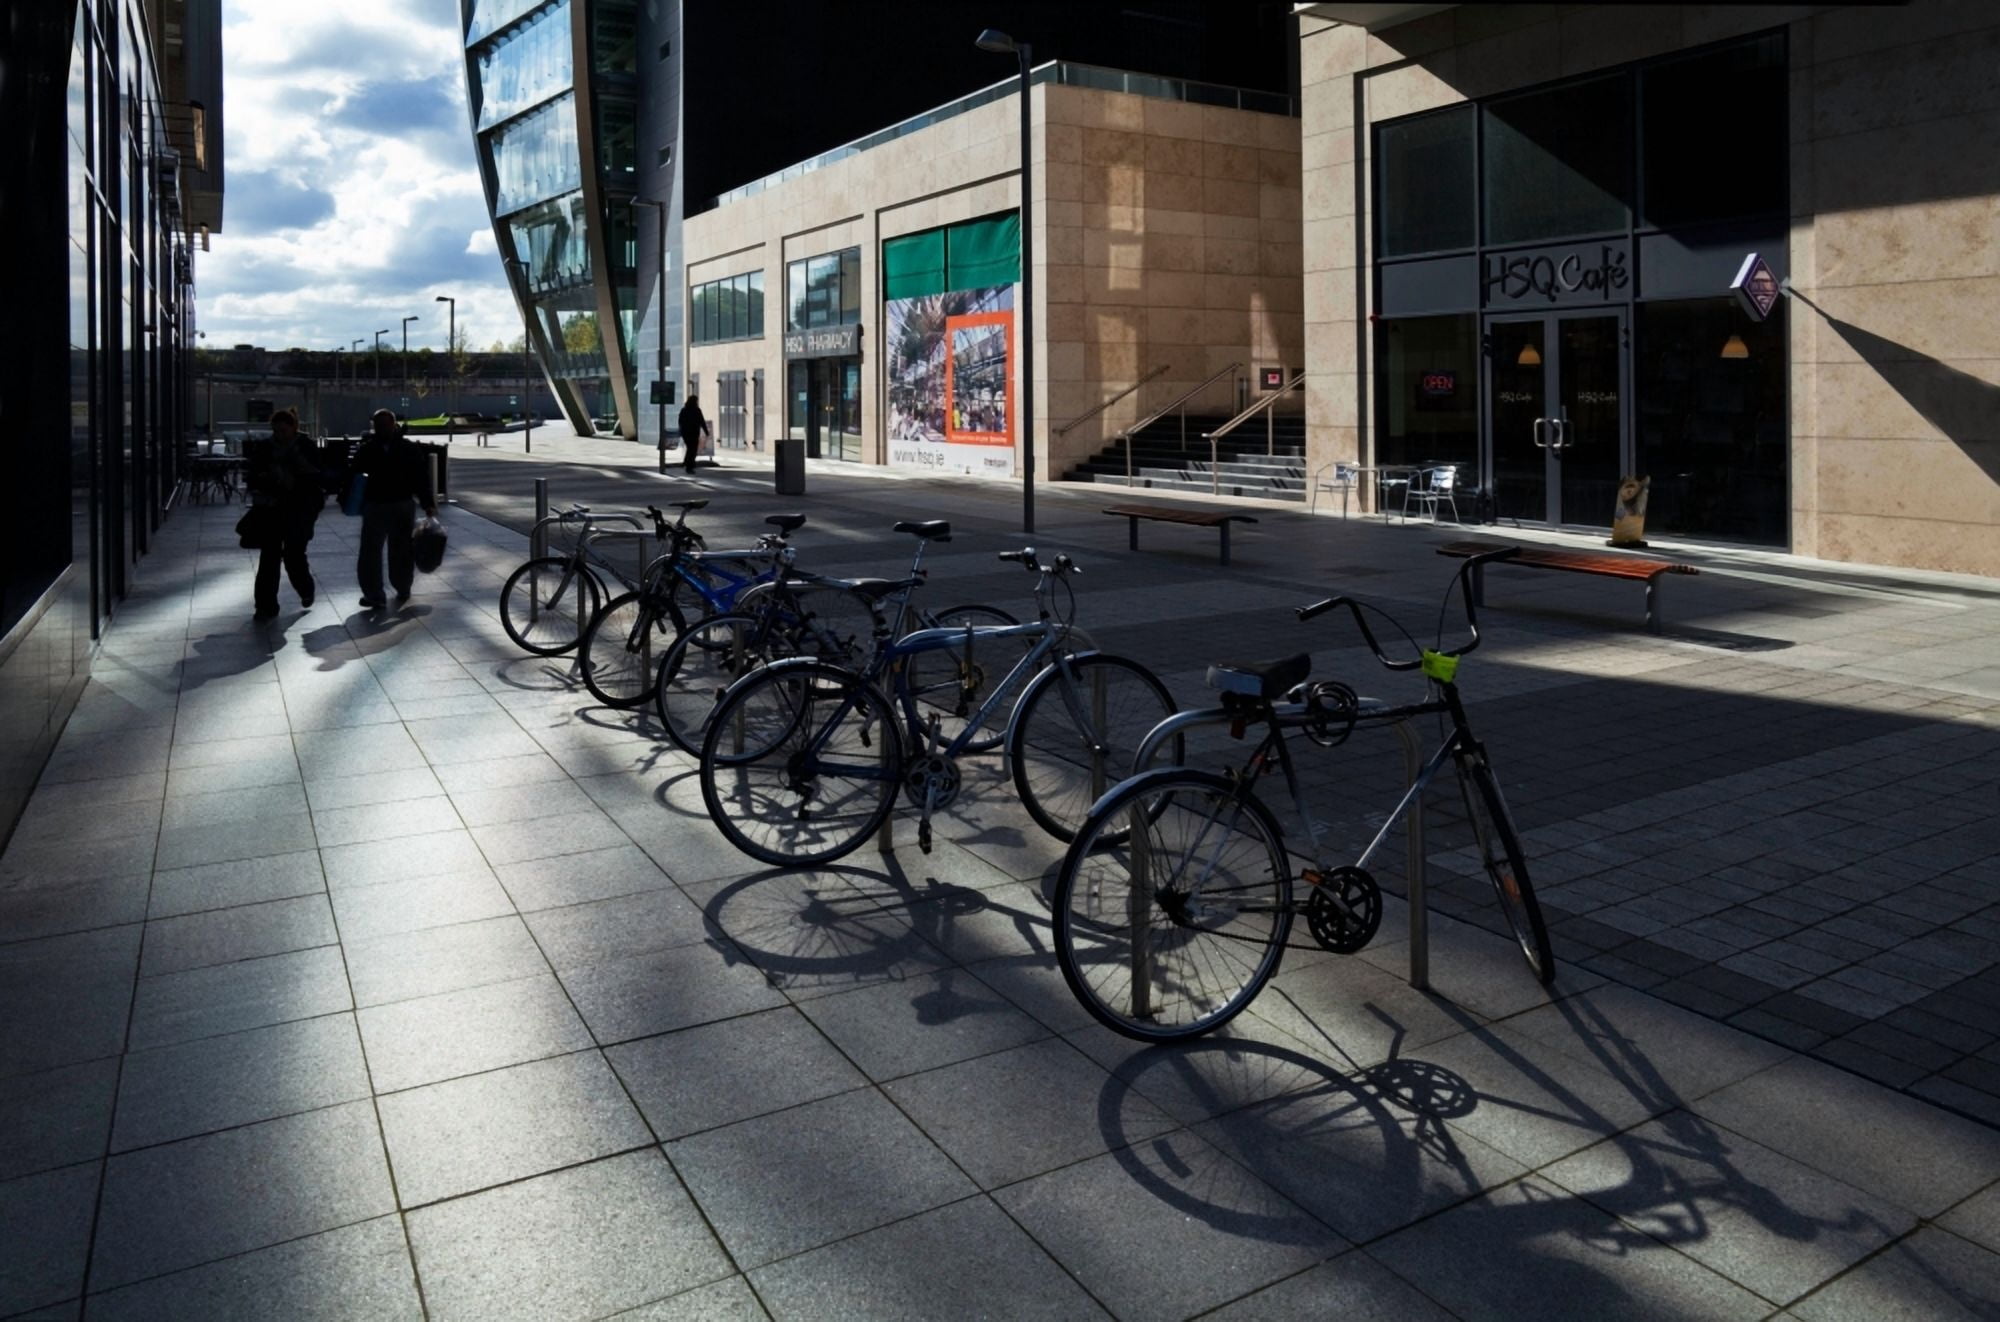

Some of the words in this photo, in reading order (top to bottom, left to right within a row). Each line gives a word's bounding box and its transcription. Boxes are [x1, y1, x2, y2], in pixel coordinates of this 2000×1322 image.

[1558, 244, 1630, 301] Café
[807, 331, 853, 352] PHARMACY
[1423, 375, 1455, 390] OPEN
